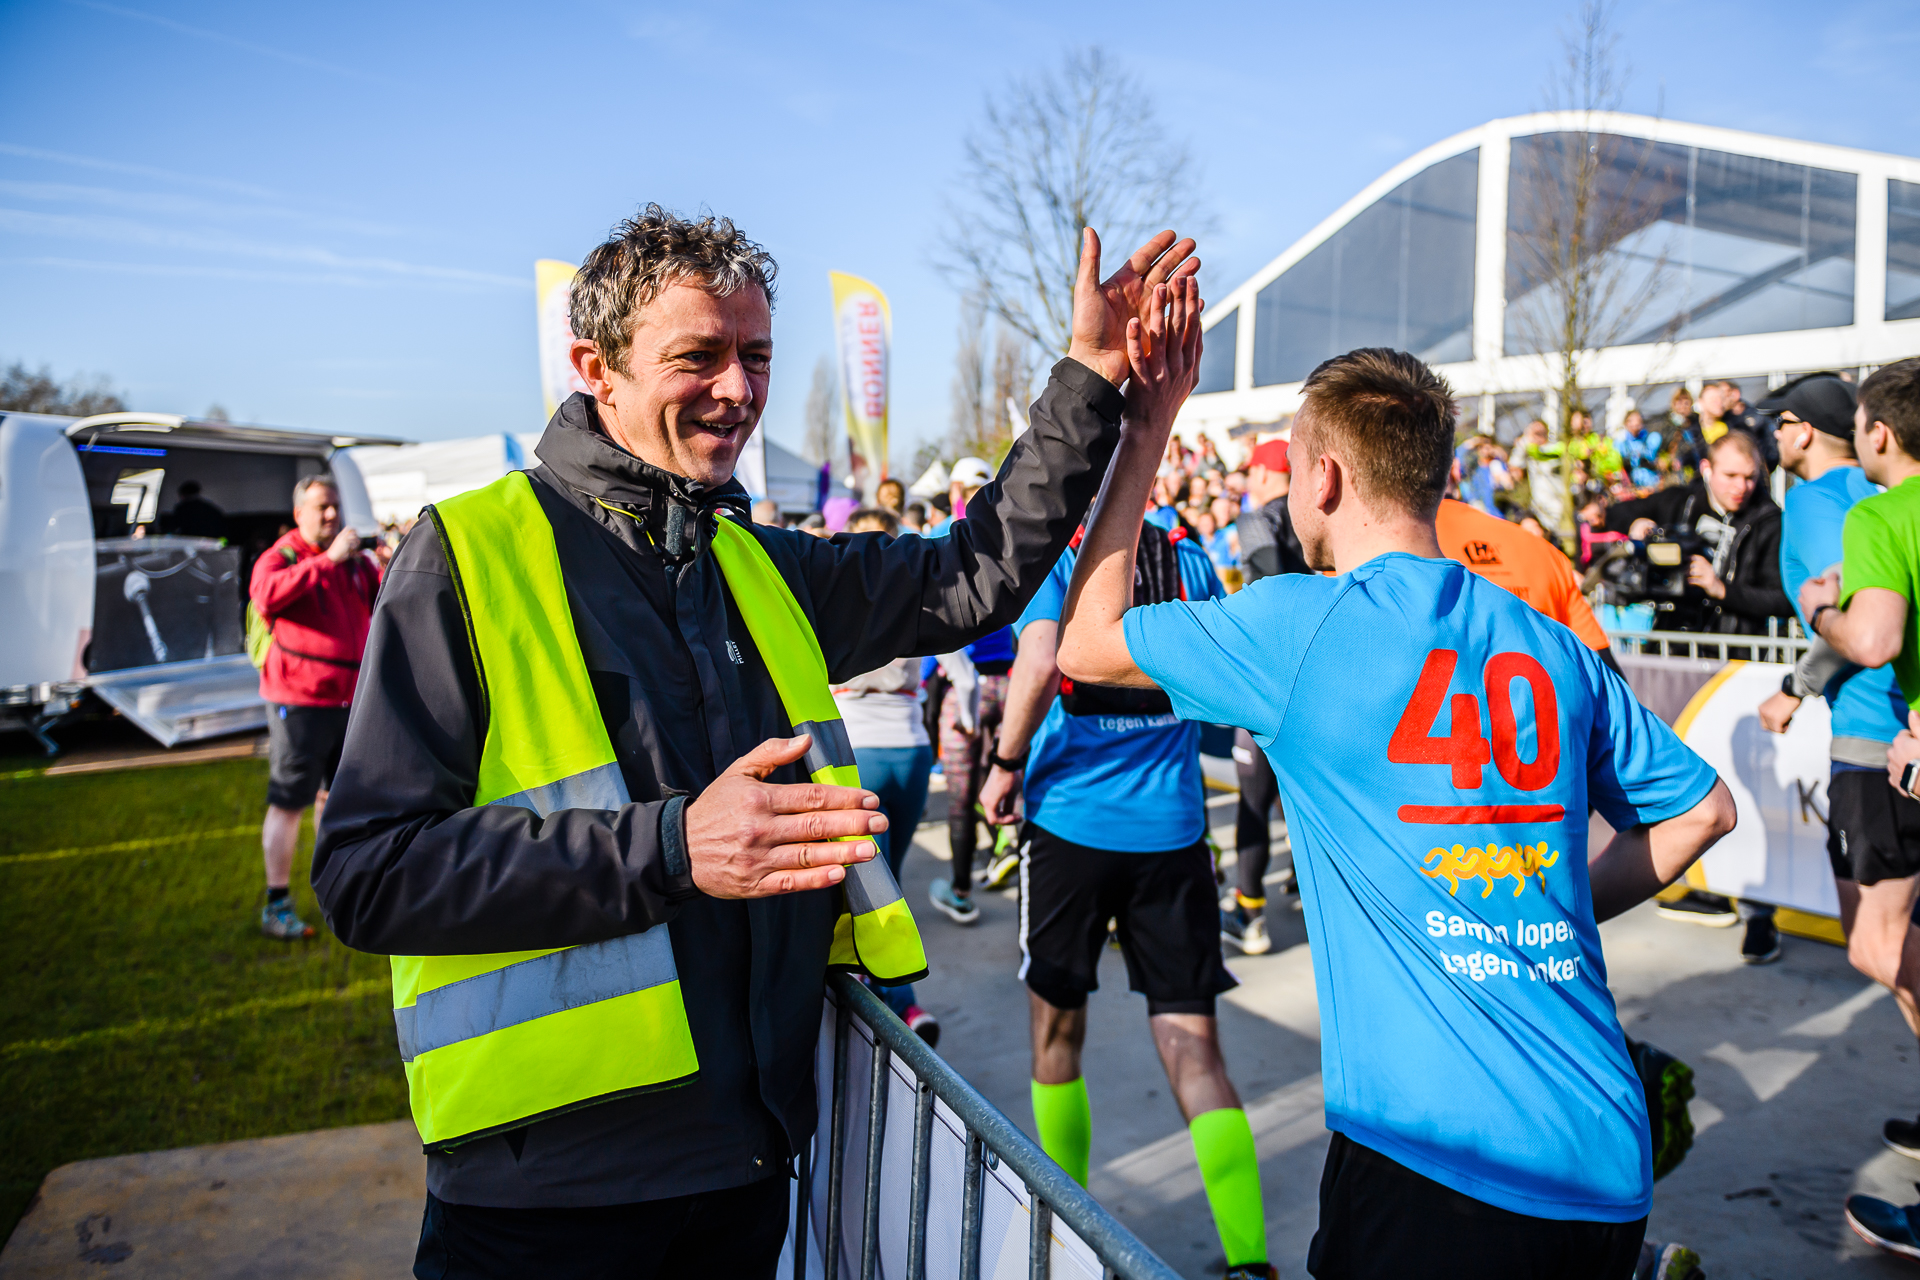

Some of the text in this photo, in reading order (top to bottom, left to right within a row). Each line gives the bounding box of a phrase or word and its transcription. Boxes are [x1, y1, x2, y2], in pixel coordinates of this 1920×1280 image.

[1100, 715, 1144, 733] tegen
[1387, 649, 1561, 791] 40
[1425, 910, 1510, 946] Samn
[1439, 950, 1519, 982] tegen
